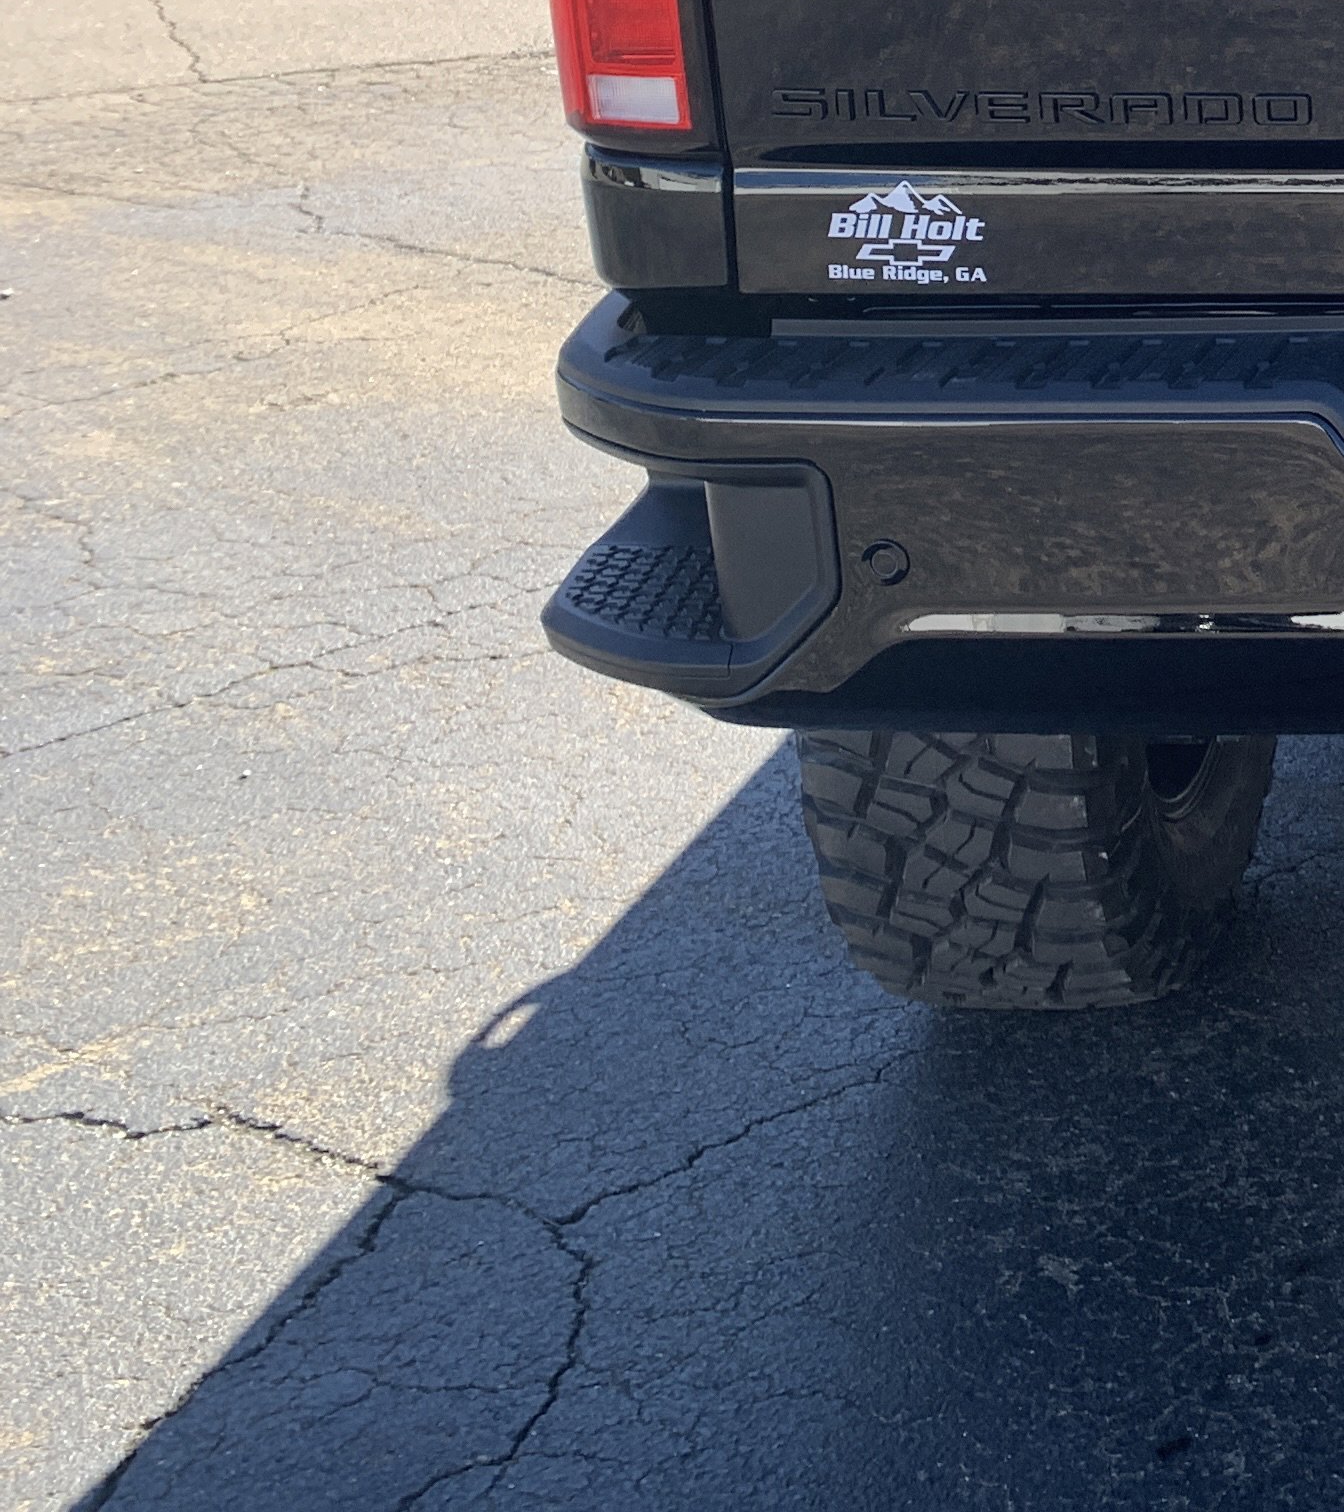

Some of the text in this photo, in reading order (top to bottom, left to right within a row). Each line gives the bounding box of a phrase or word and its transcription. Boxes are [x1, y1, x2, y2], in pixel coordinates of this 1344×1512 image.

[769, 88, 1315, 127] SILVERADO
[828, 212, 986, 242] Bill Holt
[828, 264, 988, 285] Blue Ridge, GA
